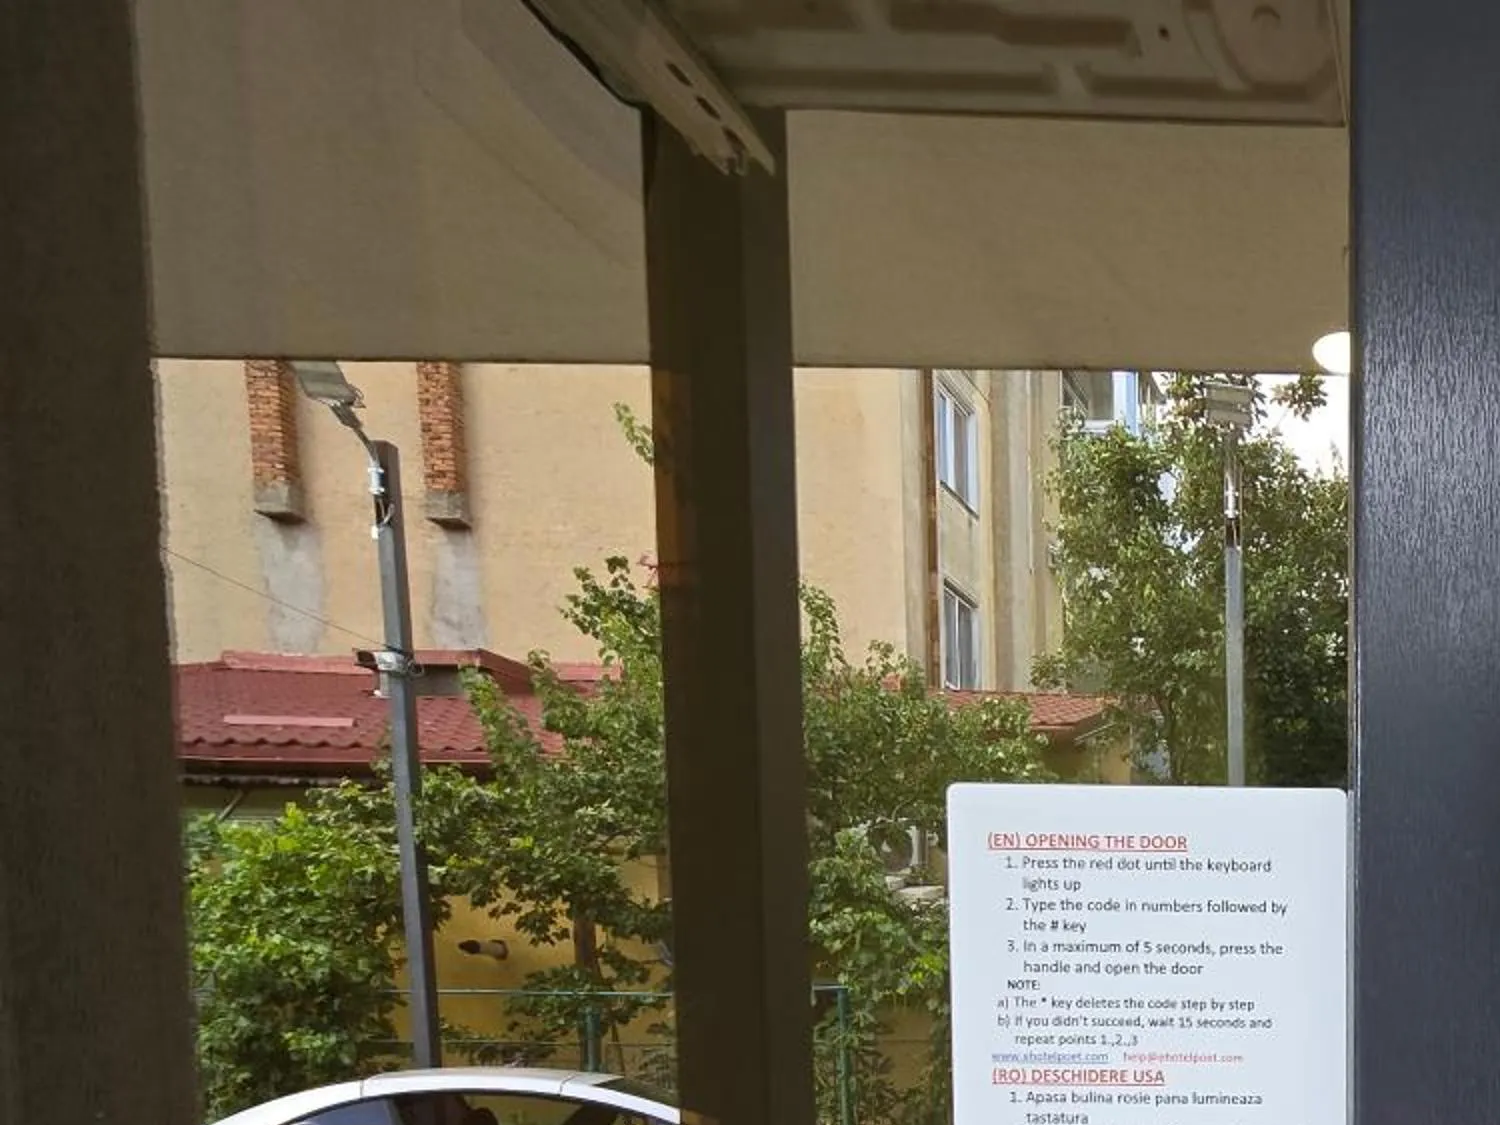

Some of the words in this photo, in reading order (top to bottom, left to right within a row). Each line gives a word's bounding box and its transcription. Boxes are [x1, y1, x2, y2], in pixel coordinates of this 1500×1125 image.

[988, 832, 1020, 849] (EN)
[1025, 834, 1100, 849] OPENING
[1104, 835, 1135, 849] THE
[1140, 836, 1187, 850] DOOR
[1006, 857, 1017, 869] 1.
[1022, 856, 1058, 869] Press
[1063, 857, 1085, 869] the
[1090, 857, 1113, 869] red
[1117, 858, 1141, 870] dot
[1145, 858, 1176, 871] until
[1180, 858, 1203, 871] the
[1207, 858, 1272, 873] keyboard
[1022, 878, 1059, 891] lights
[1063, 882, 1081, 892] up
[1006, 898, 1018, 911] 2.
[1022, 898, 1056, 913] Type
[1060, 898, 1083, 911] the
[1087, 898, 1120, 911] code
[1126, 898, 1137, 911] in
[1141, 900, 1203, 913] numbers
[1207, 900, 1267, 913] followed
[1271, 901, 1288, 916] by
[1023, 919, 1046, 931] the
[1050, 919, 1059, 931] #
[1063, 919, 1086, 934] key
[1007, 940, 1019, 952] 3.
[1023, 940, 1037, 952] In
[1041, 943, 1049, 952] a
[1053, 941, 1121, 953] maximum
[1125, 940, 1140, 953] of
[1143, 941, 1152, 953] 5
[1156, 941, 1216, 956] seconds,
[1220, 945, 1256, 957] press
[1260, 942, 1283, 955] the
[1023, 961, 1071, 973] handle
[1075, 961, 1101, 973] and
[1105, 964, 1141, 976] open
[1143, 962, 1167, 974] the
[1171, 962, 1204, 975] door
[1007, 979, 1040, 990] NOTE:
[997, 996, 1009, 1010] a)
[1014, 996, 1037, 1008] The
[1051, 997, 1072, 1011] key
[1075, 997, 1121, 1009] deletes
[1123, 997, 1145, 1009] the
[1147, 997, 1177, 1009] code
[1182, 999, 1207, 1012] step
[1211, 998, 1225, 1012] by
[1229, 999, 1255, 1012] step
[997, 1014, 1010, 1029] b)
[1014, 1015, 1023, 1027] If
[1026, 1018, 1049, 1030] you
[1051, 1015, 1088, 1027] didn't
[1091, 1016, 1145, 1029] succeed,
[1148, 1016, 1175, 1028] wait
[1179, 1017, 1193, 1028] 15
[1196, 1017, 1246, 1029] seconds
[1249, 1018, 1273, 1029] and
[1014, 1035, 1055, 1047] repeat
[1058, 1034, 1097, 1047] points
[992, 1068, 1027, 1084] (RO)
[1031, 1069, 1128, 1084] DESCHIDERE
[1133, 1070, 1165, 1084] USA
[1009, 1091, 1022, 1103] 1.
[1025, 1091, 1067, 1105] Apasa
[1071, 1090, 1113, 1103] bulina
[1117, 1091, 1151, 1104] rosie
[1155, 1095, 1189, 1107] pana
[1192, 1091, 1263, 1105] lumineaza
[1026, 1112, 1089, 1125] tastatura
